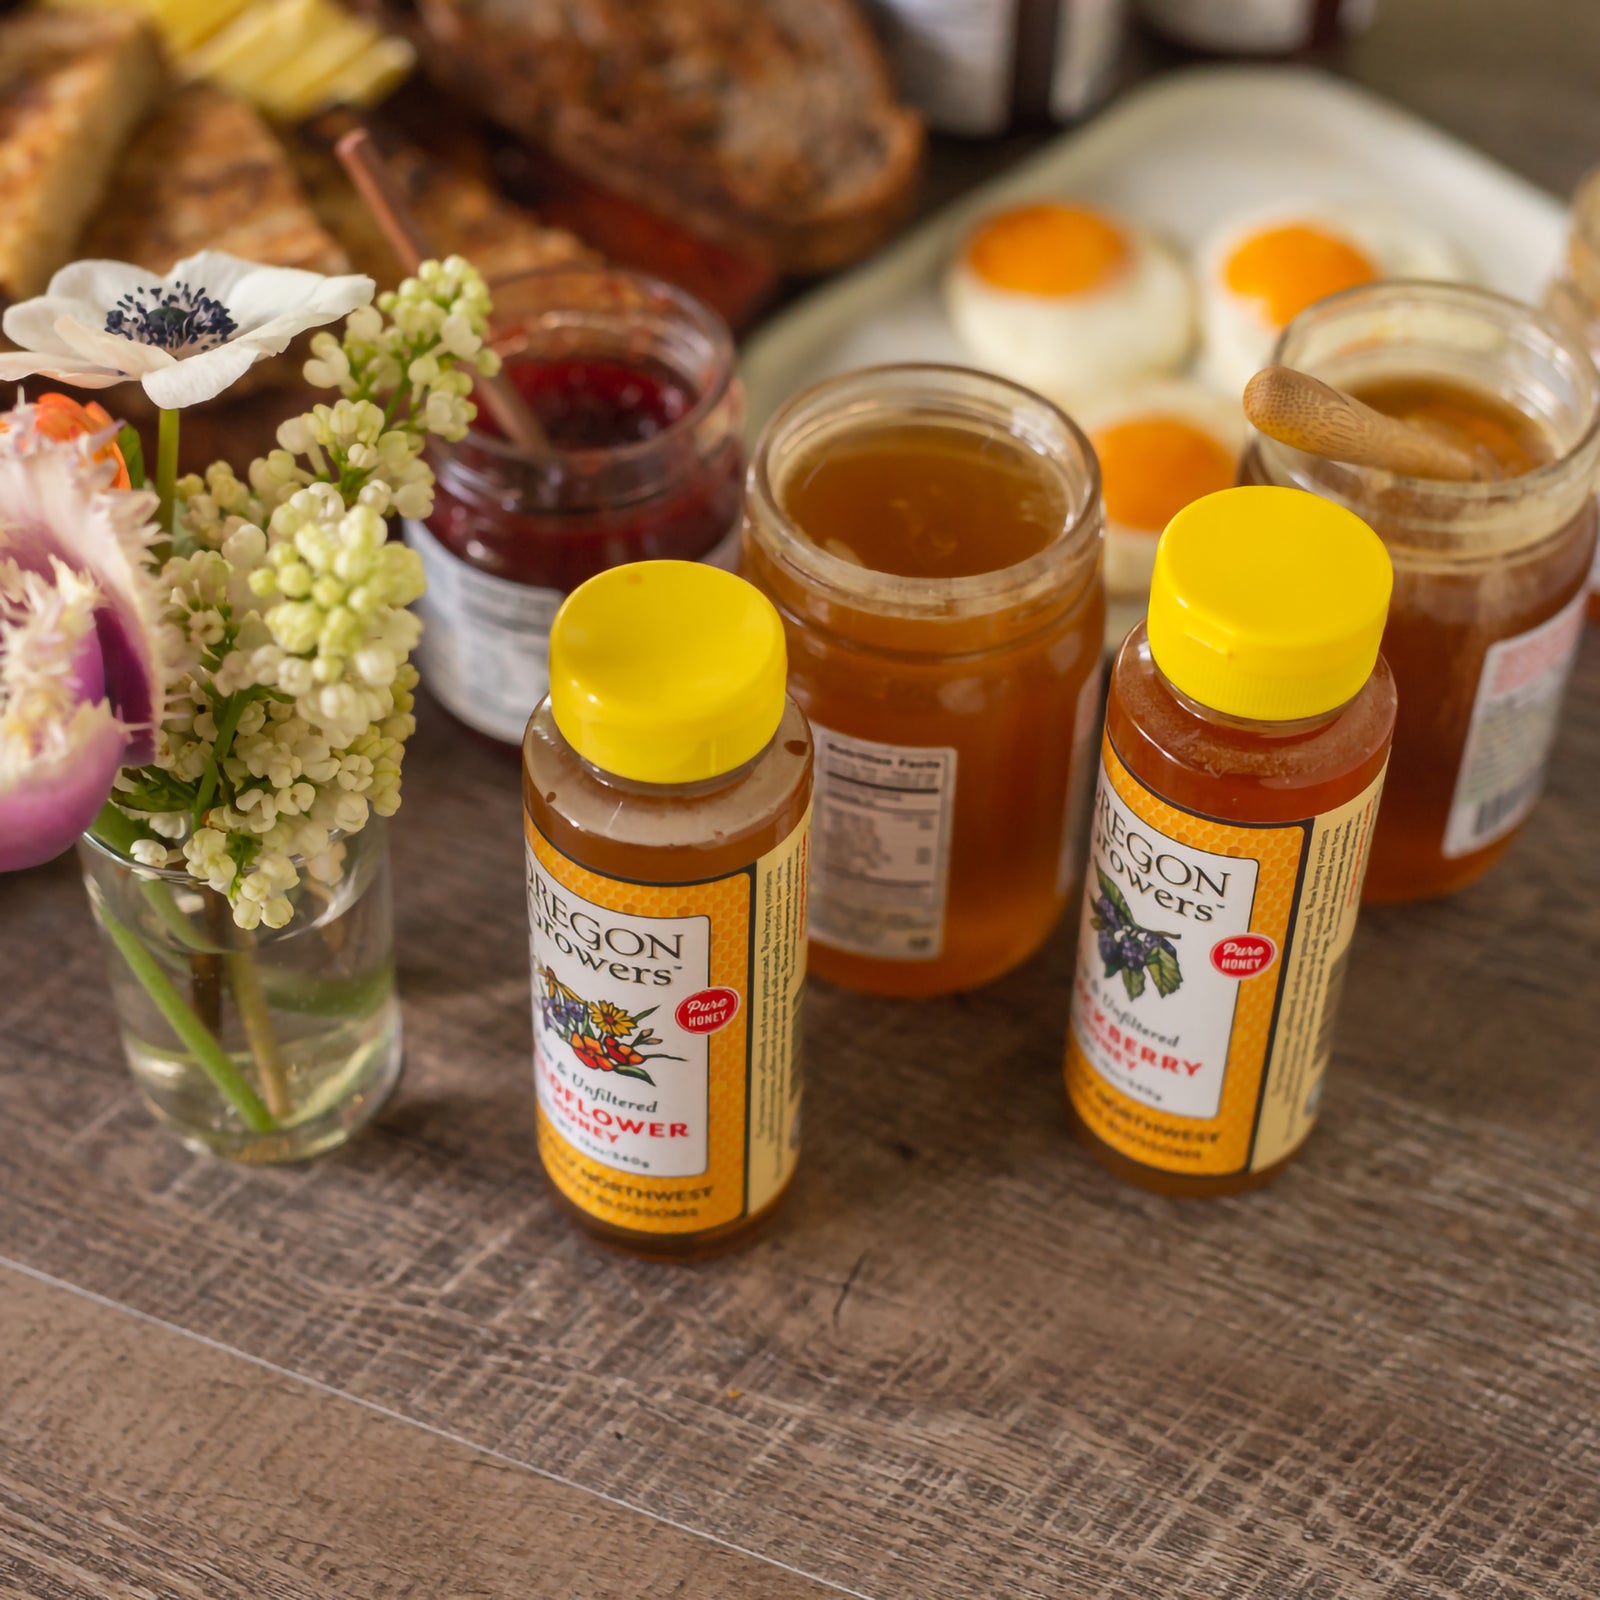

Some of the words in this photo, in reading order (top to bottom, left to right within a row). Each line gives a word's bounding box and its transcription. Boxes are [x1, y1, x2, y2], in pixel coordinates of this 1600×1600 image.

[1098, 788, 1232, 898] REGON
[1223, 942, 1265, 957] Pure
[1221, 958, 1262, 971] HONEY
[687, 997, 727, 1013] Pure
[687, 1009, 727, 1028] HONEY
[533, 1042, 690, 1139] DFLOWER
[572, 1072, 658, 1113] Unfiltered
